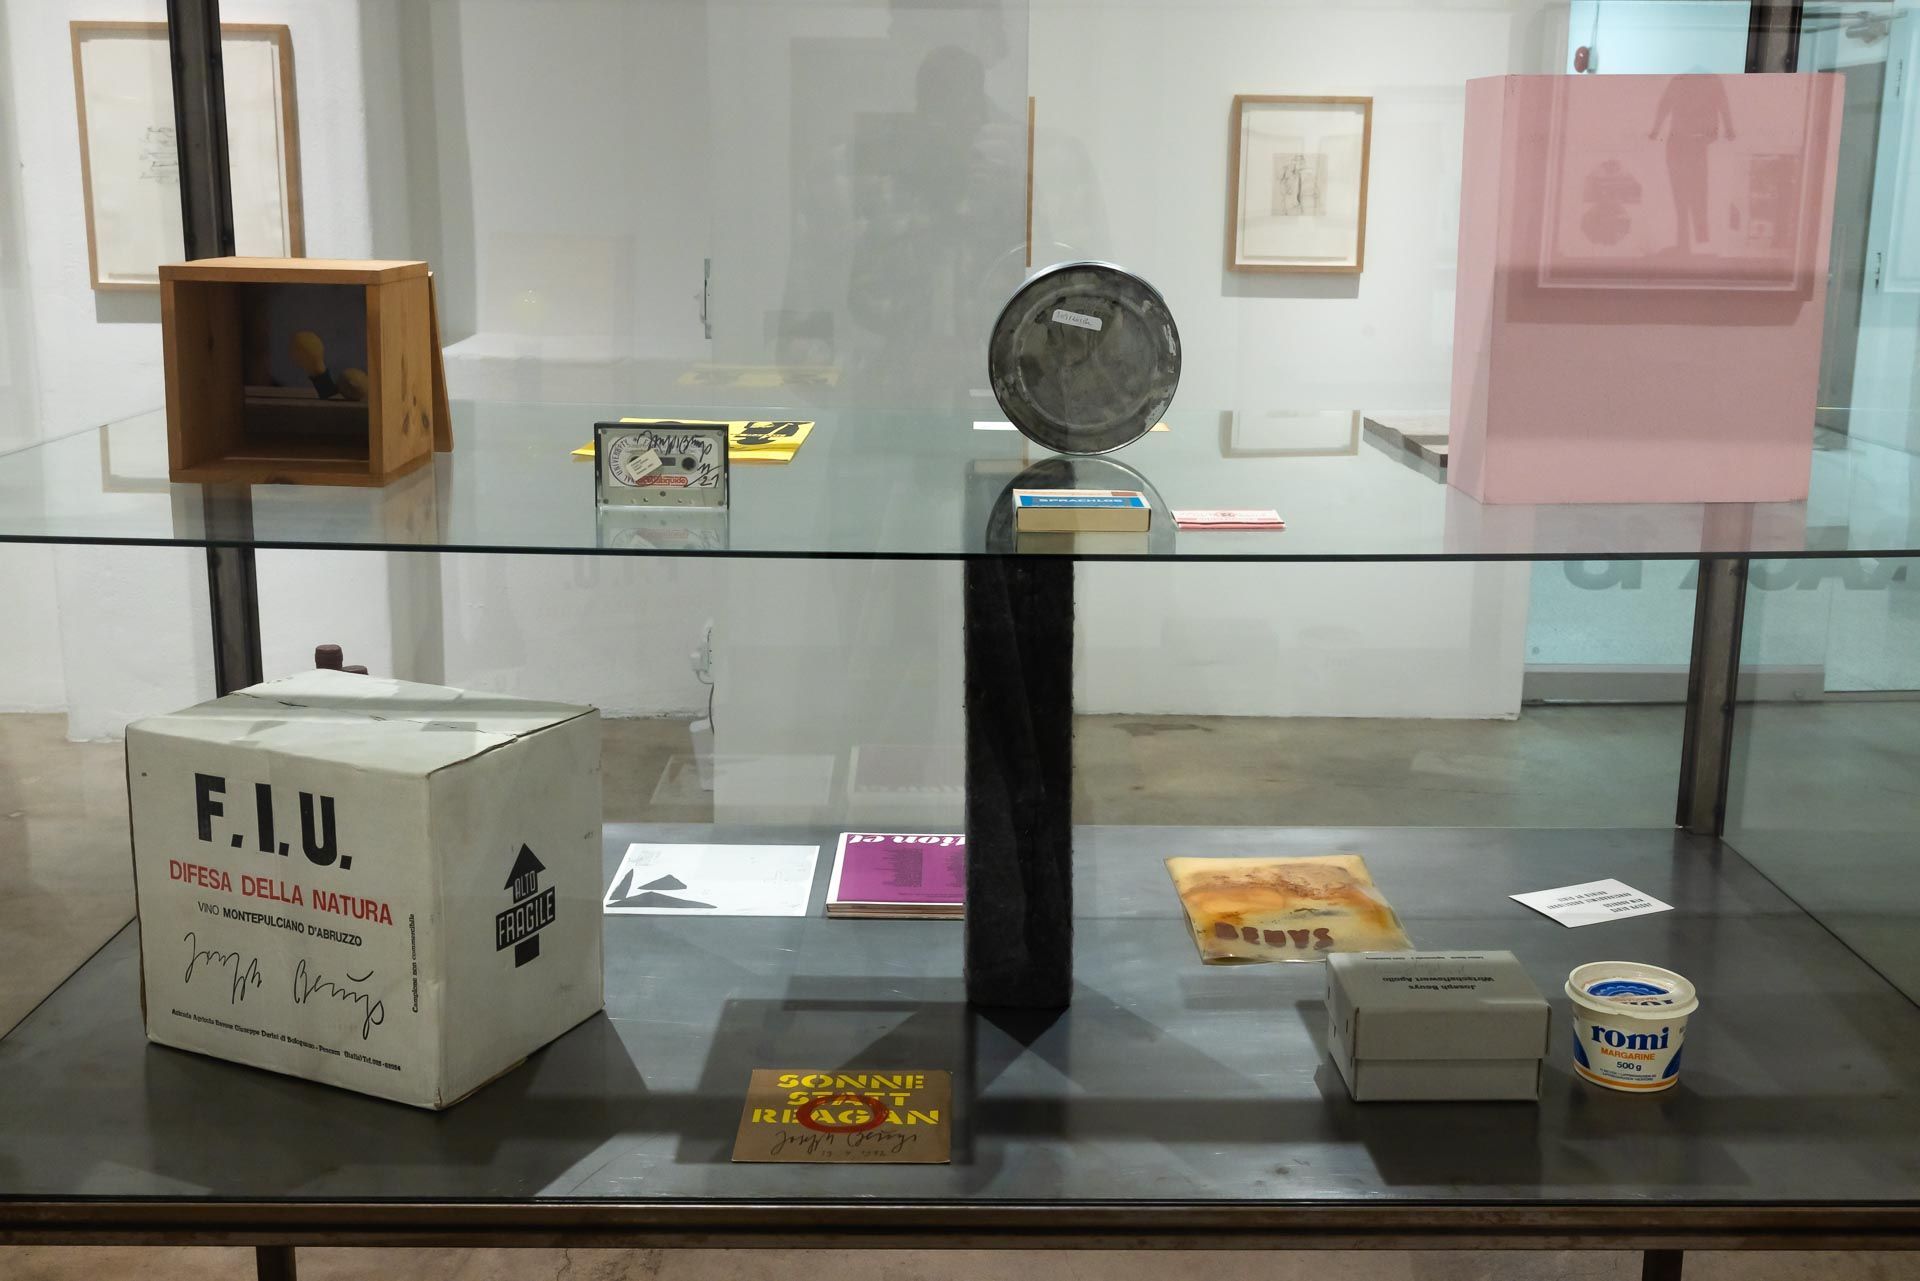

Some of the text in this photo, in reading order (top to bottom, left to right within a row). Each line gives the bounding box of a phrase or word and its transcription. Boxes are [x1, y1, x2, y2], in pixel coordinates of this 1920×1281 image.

[195, 773, 352, 870] F.I.U.
[169, 859, 393, 926] DIFESA DELLA NATURA
[514, 870, 536, 899] ALTO
[198, 901, 362, 946] VINO MONTEPULCIANO D'ABRUZZO
[499, 891, 554, 946] FRAGILE
[1591, 1025, 1669, 1050] romi
[1601, 1047, 1656, 1060] MARGARINE
[1616, 1061, 1635, 1070] 500
[777, 1074, 924, 1089] SONNE
[787, 1091, 910, 1107] STATT
[752, 1108, 939, 1124] REAGAN
